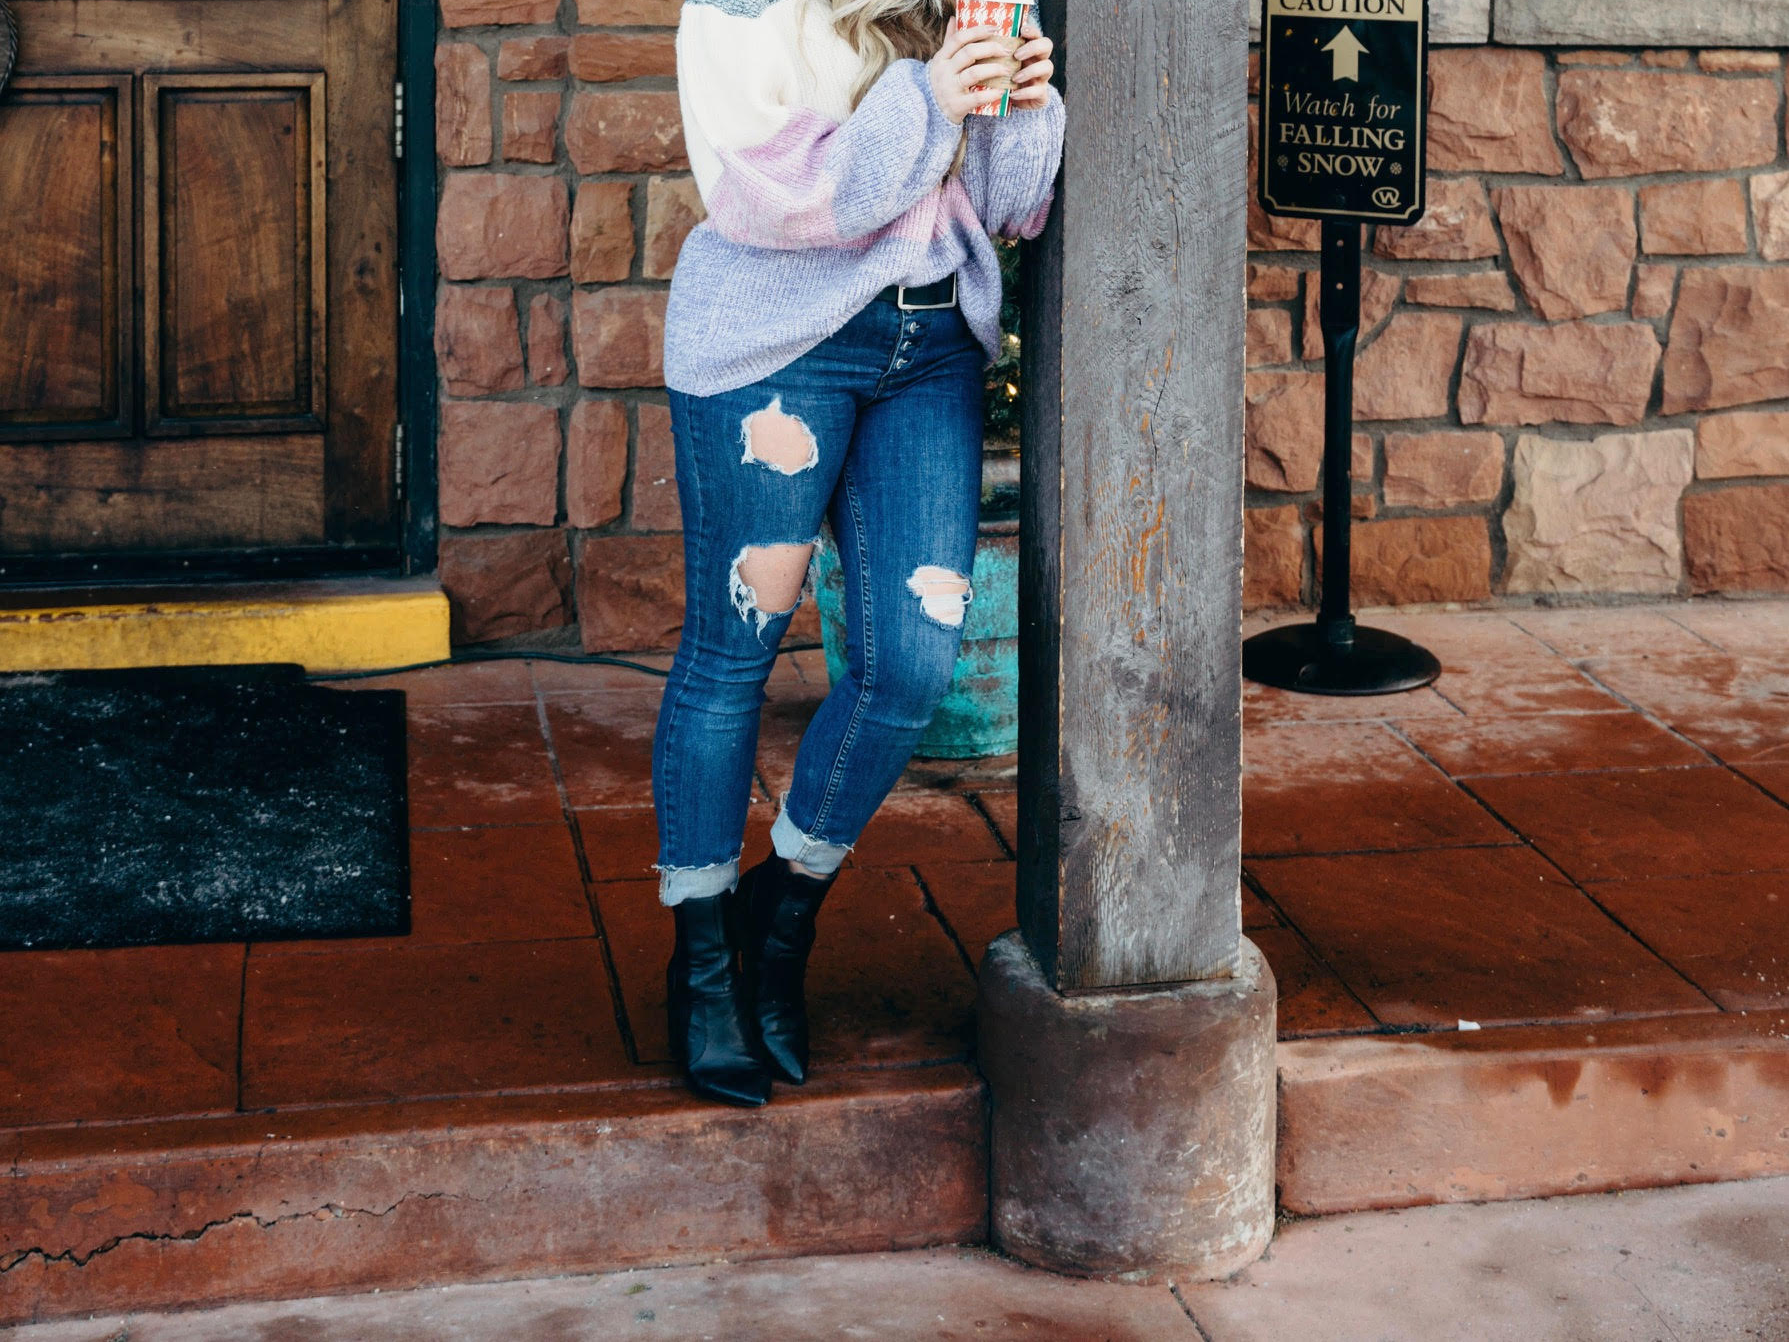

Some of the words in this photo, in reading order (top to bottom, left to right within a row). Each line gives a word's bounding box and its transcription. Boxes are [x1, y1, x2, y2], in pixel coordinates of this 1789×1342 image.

[1284, 91, 1356, 118] Watch
[1366, 94, 1401, 124] for
[1280, 122, 1405, 150] FALLING
[1298, 152, 1385, 178] SNOW
